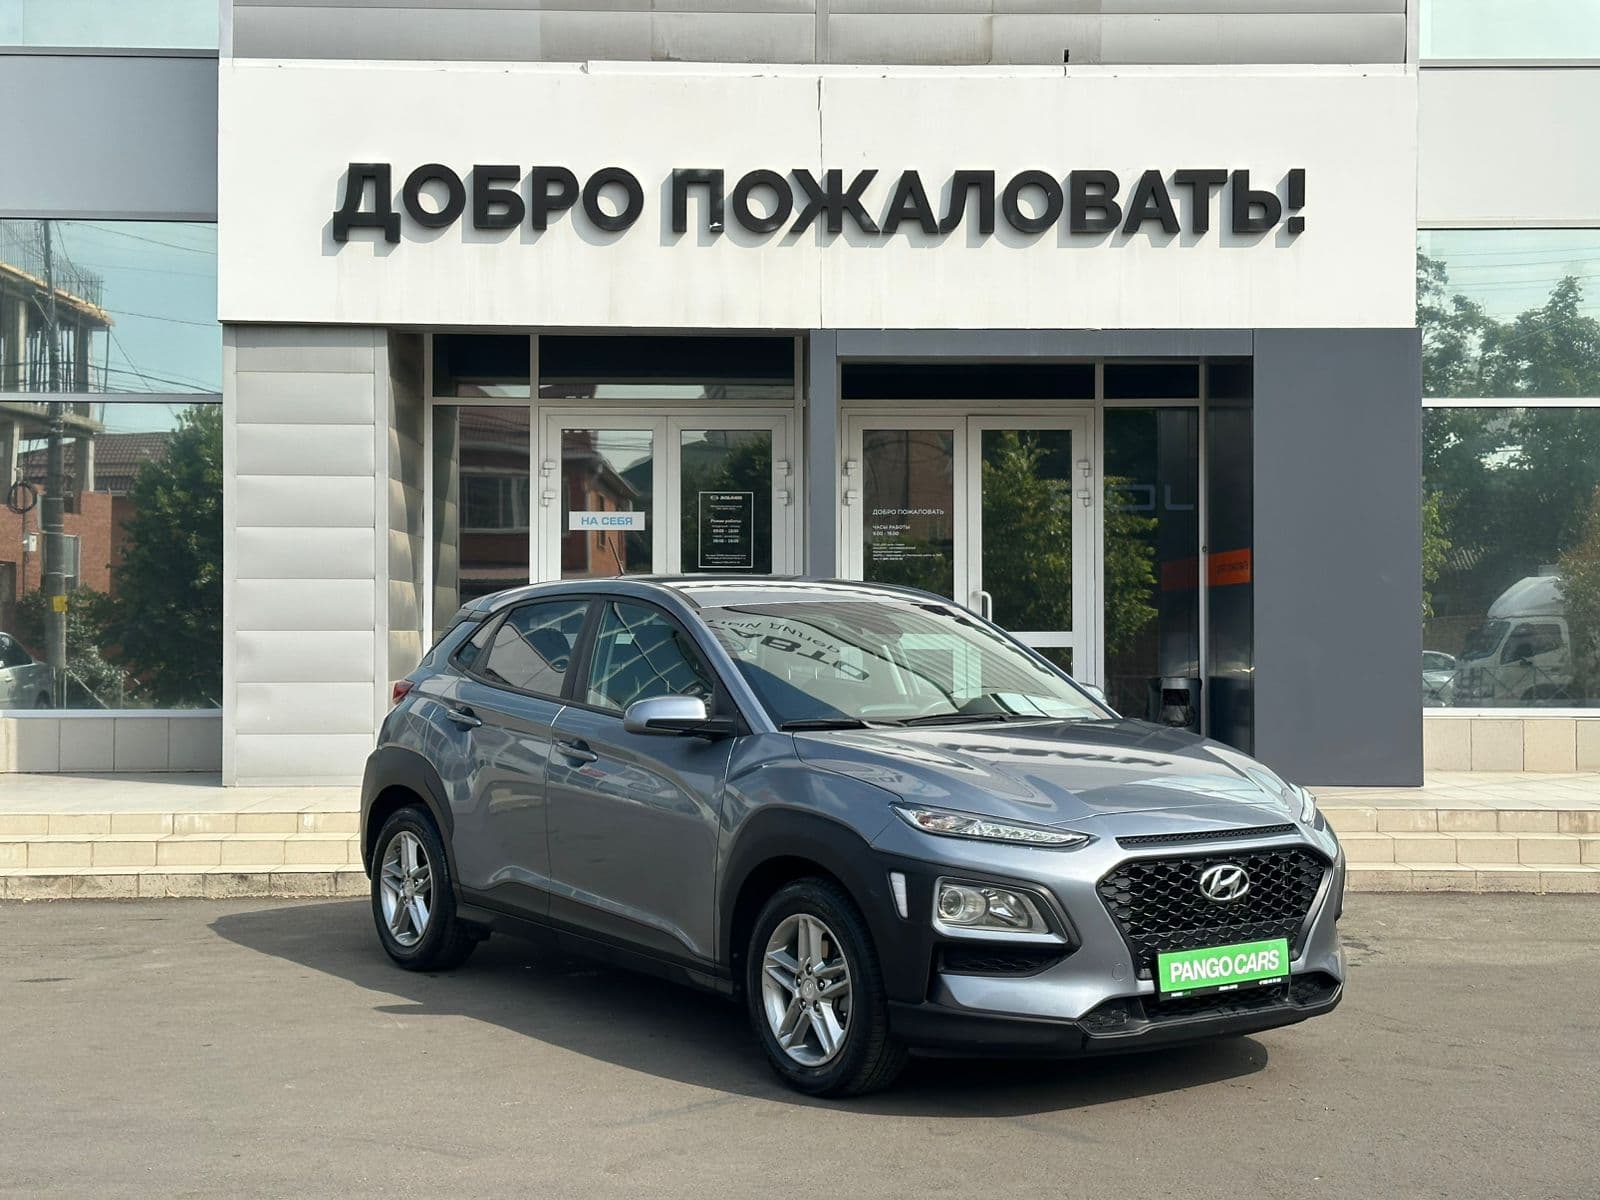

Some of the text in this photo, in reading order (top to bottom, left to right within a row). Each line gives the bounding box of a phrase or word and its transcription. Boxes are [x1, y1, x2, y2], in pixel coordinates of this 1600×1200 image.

[333, 162, 1305, 243] ДОБРО ПОЖАЛОВАТЬ!
[581, 516, 632, 526] НА СЕБЯ
[1170, 950, 1280, 983] PANGO CARS
